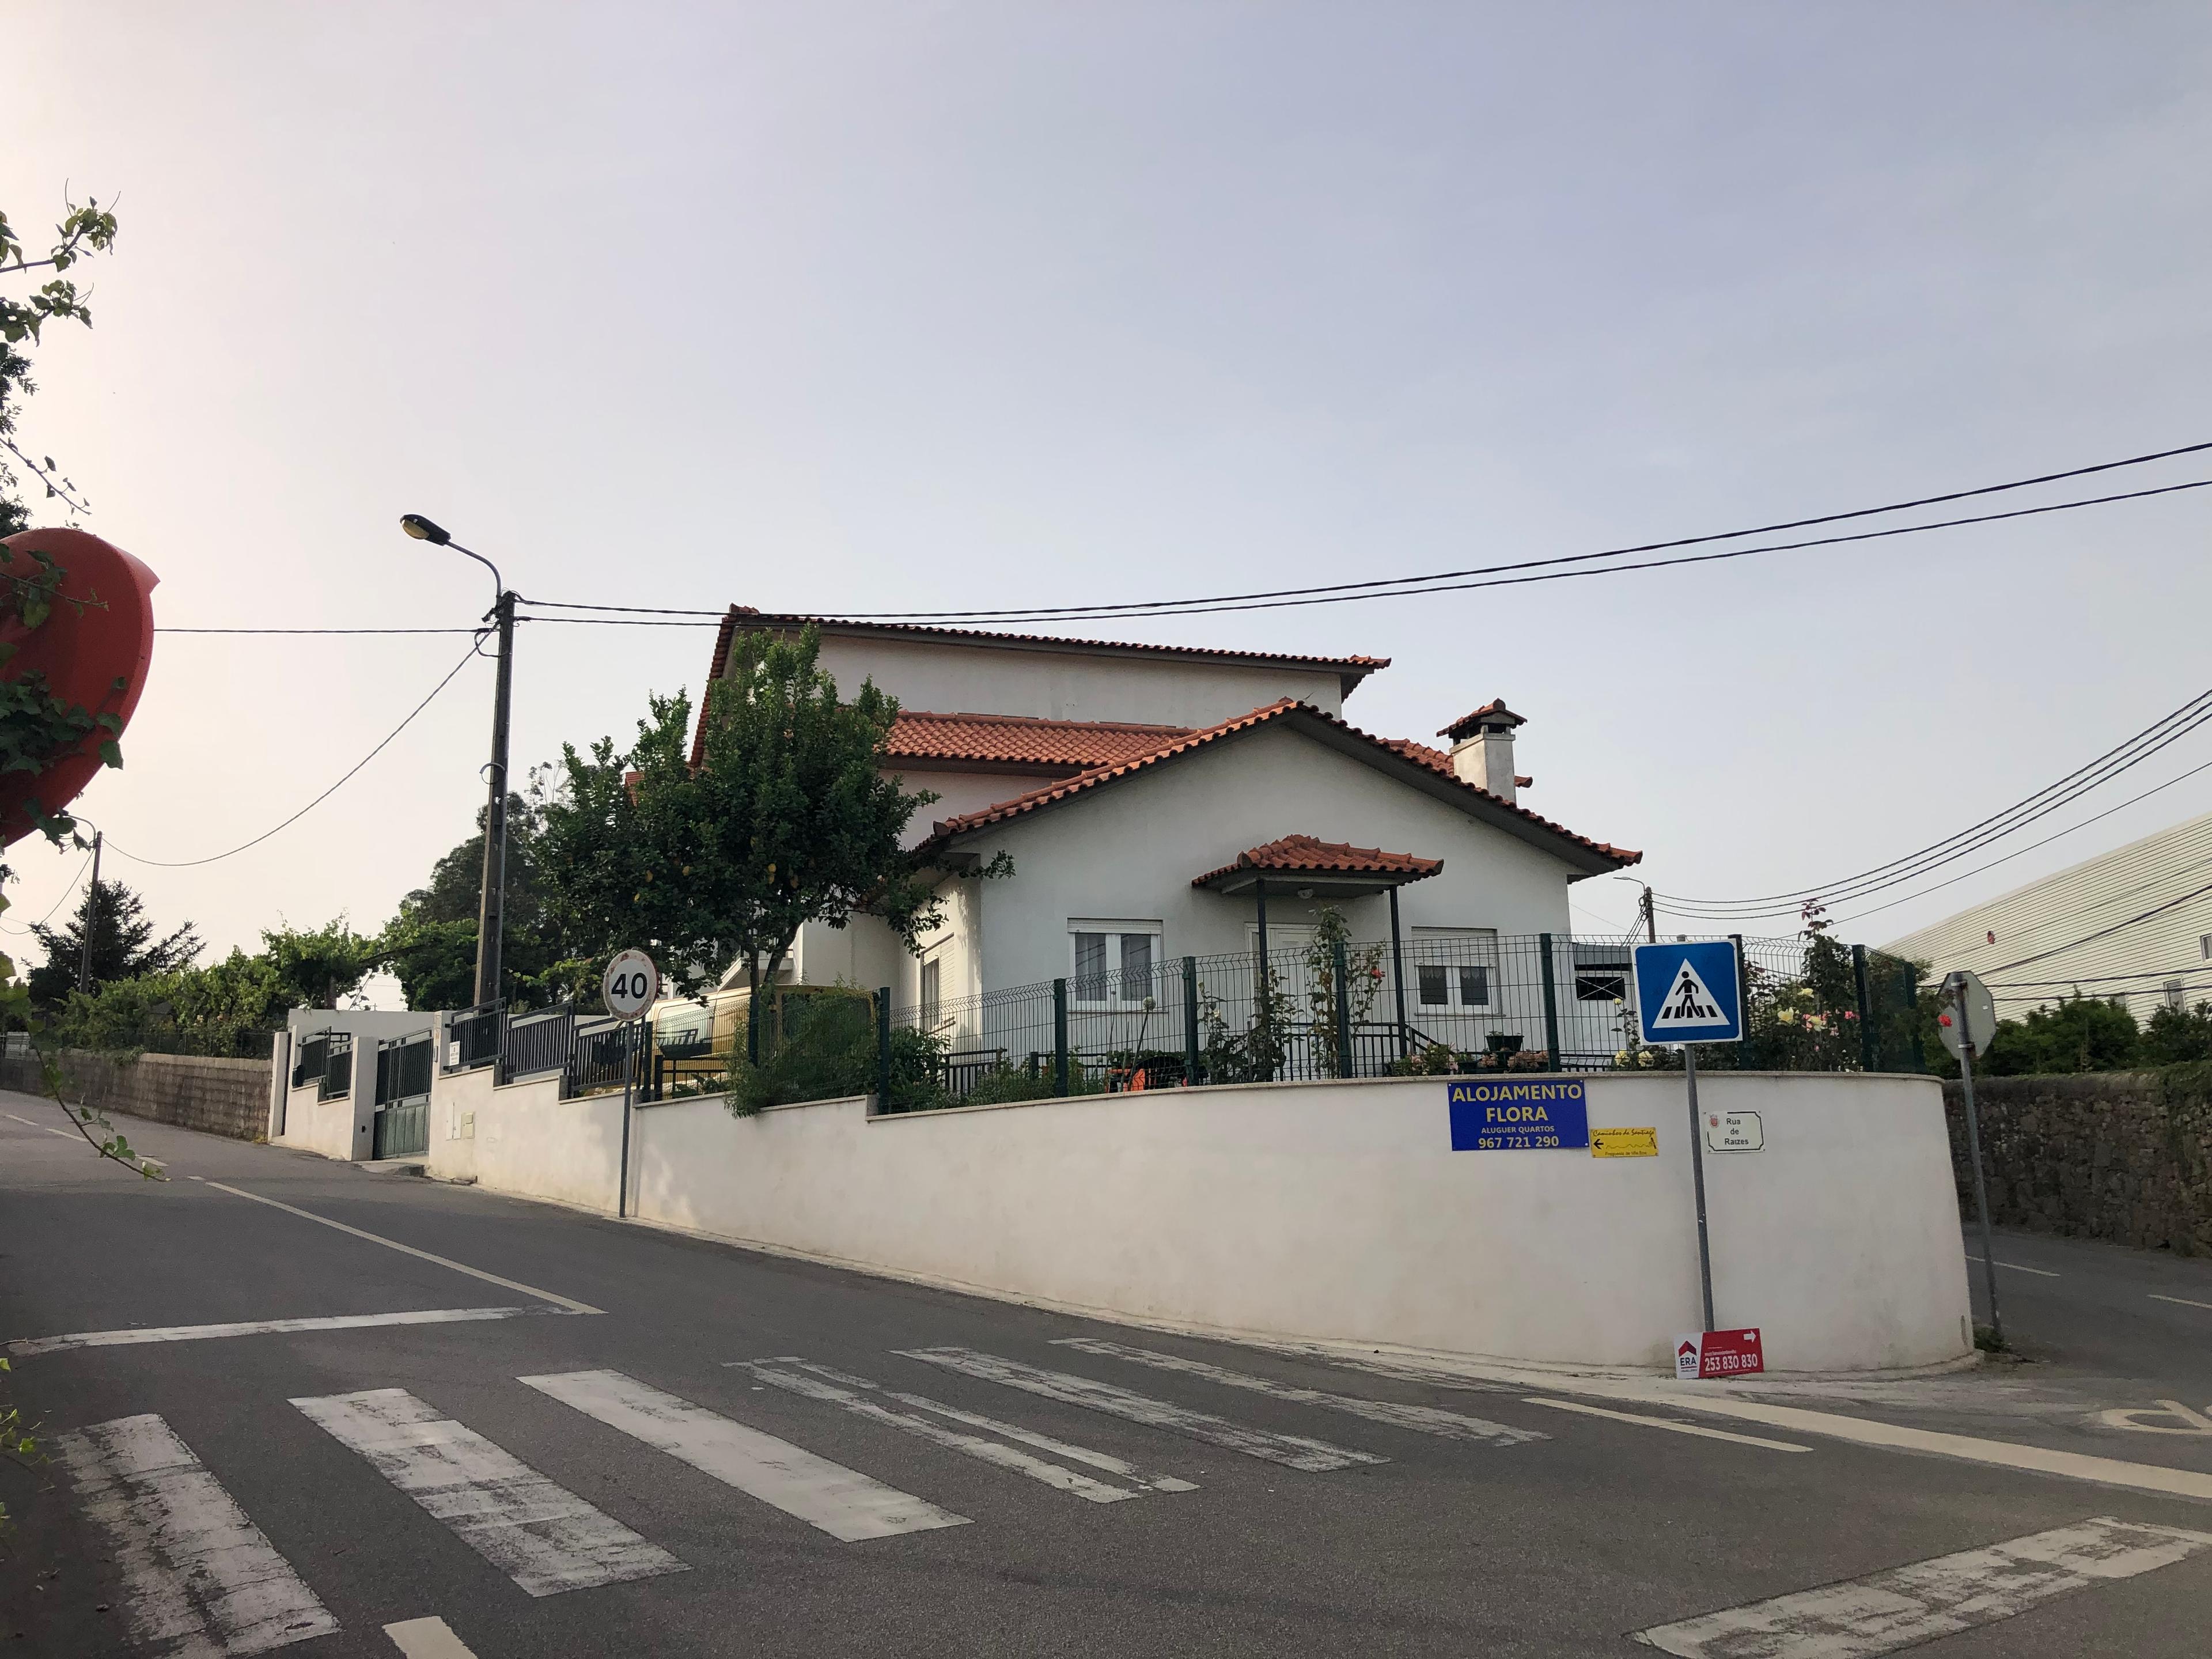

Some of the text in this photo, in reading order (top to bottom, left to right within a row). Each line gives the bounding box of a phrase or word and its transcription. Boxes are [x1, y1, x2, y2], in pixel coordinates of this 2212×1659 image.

[611, 972, 647, 999] 40
[1452, 1084, 1582, 1102] ALOJAMENTO
[1486, 1106, 1548, 1122] FLORA
[1518, 1126, 1555, 1134] QUARTOS
[1478, 1135, 1559, 1149] 967 721 290
[1680, 1357, 1697, 1366] ERA
[1705, 1354, 1758, 1372] 253 830 830
